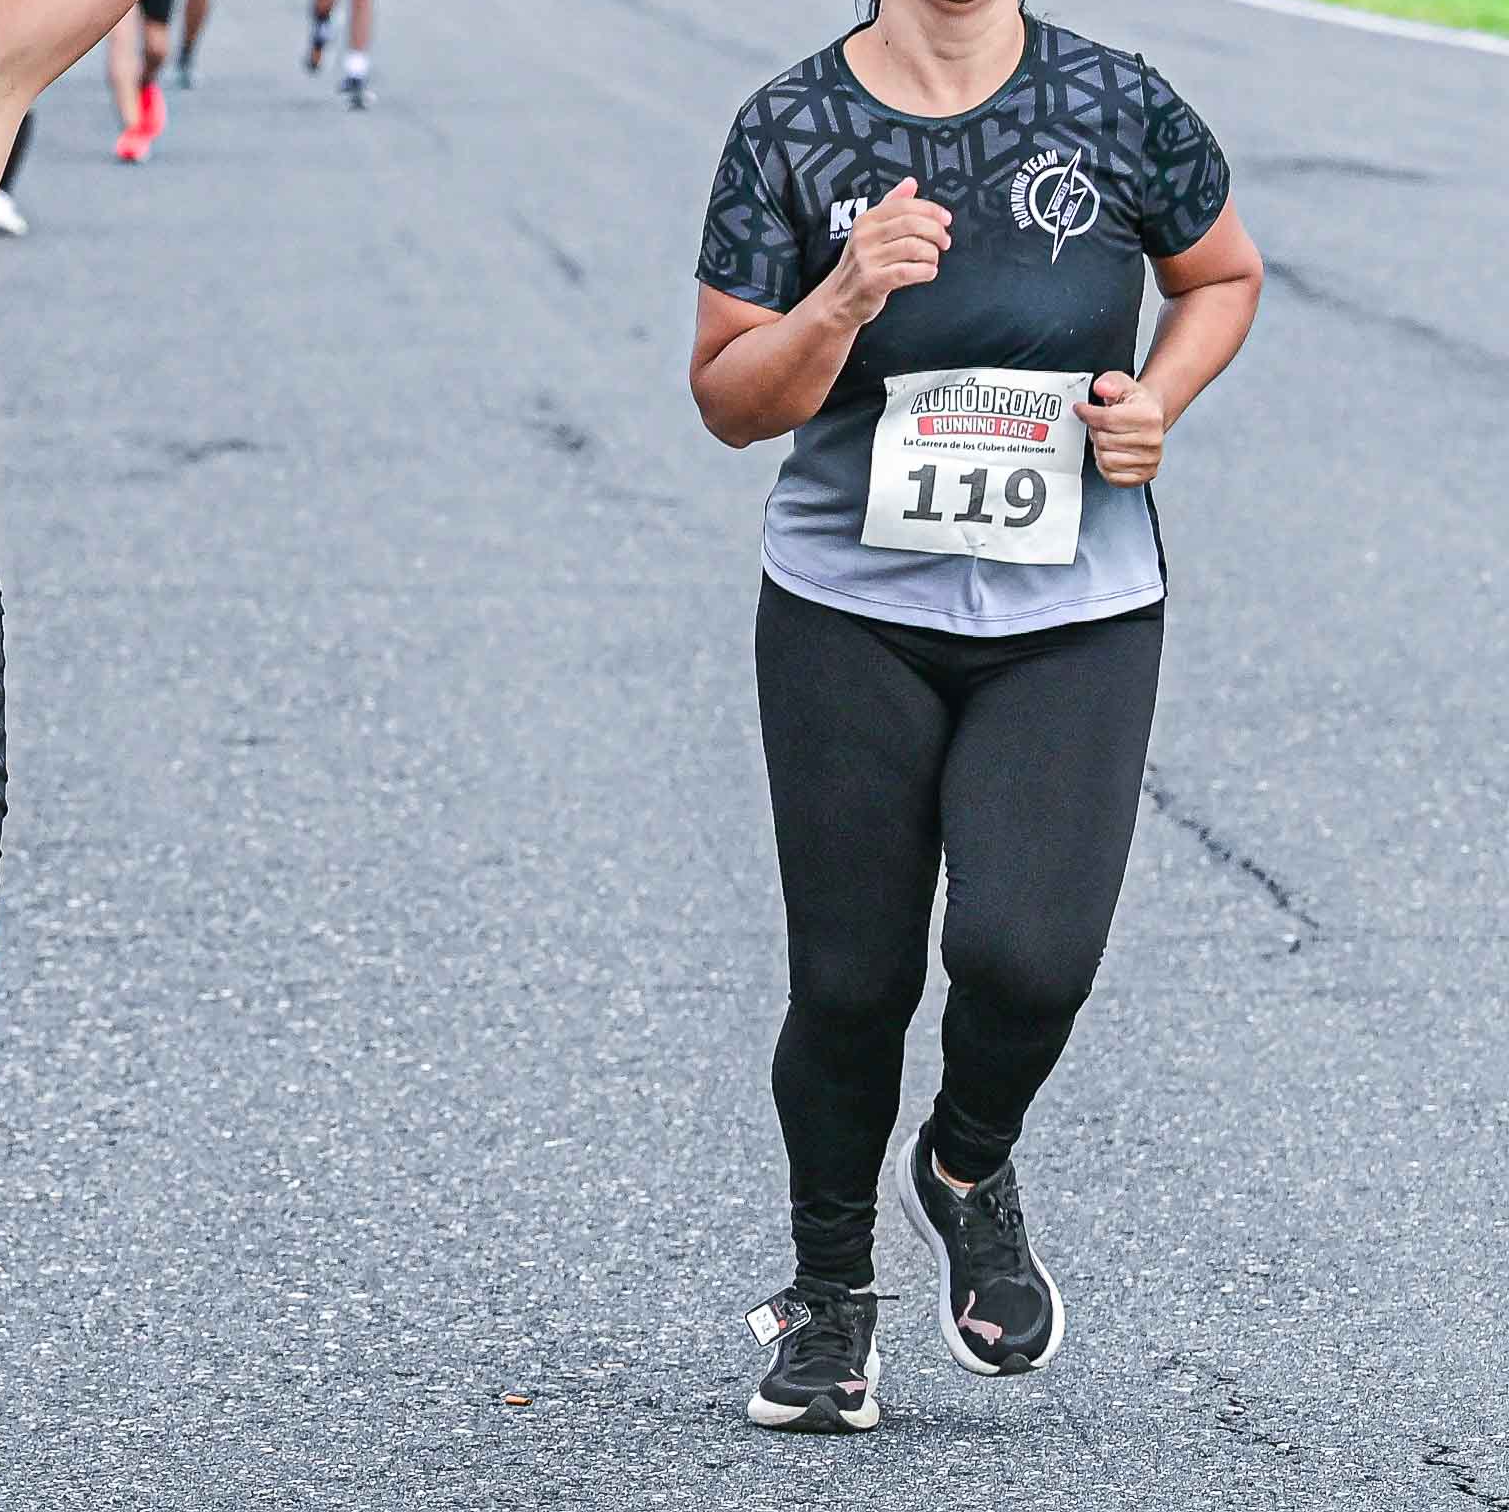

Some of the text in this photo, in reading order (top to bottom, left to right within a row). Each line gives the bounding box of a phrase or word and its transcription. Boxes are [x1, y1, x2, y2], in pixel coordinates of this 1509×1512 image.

[1010, 149, 1059, 230] RUNNING TEAM
[910, 376, 1063, 422] AUTÓDROMO
[903, 436, 1056, 455] La Carrera de los Clubes del Noroeste
[932, 417, 1037, 439] RUNNING RACE
[902, 463, 1048, 528] 119
